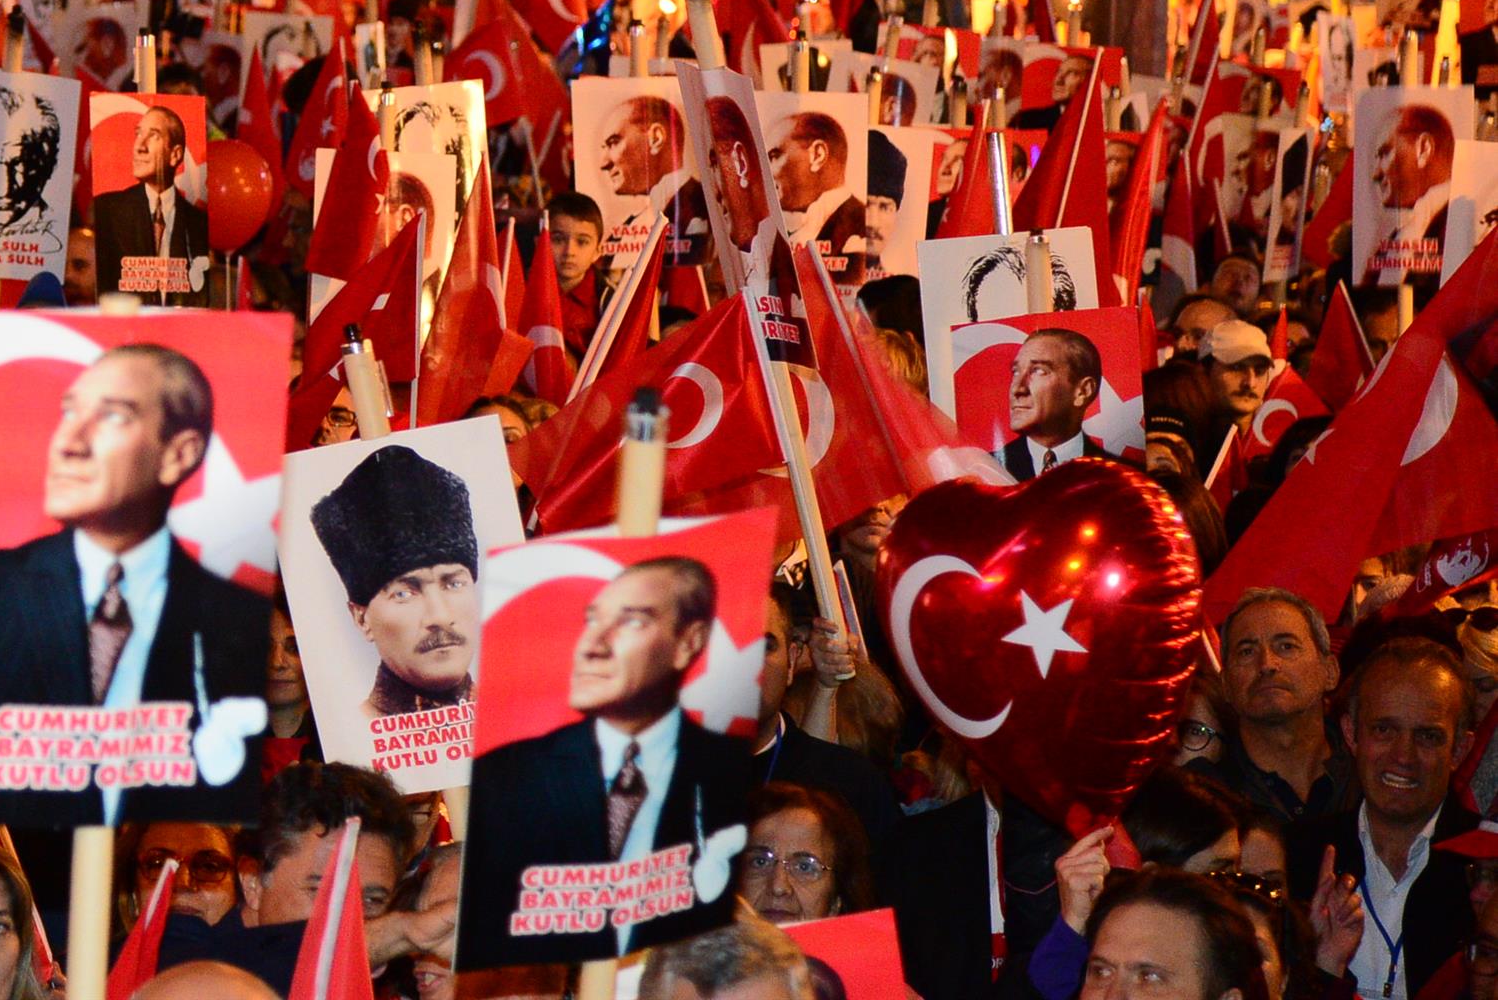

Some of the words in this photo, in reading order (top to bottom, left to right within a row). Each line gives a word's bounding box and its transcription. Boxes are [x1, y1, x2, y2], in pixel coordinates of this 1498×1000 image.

[3, 241, 39, 253] SULH
[7, 254, 45, 266] SULH
[120, 281, 157, 291] KUTLU
[369, 700, 476, 735] CUMHURİ
[373, 722, 476, 754] BAYRAMI
[371, 749, 439, 772] KUTLU
[99, 761, 194, 786] OLSUN
[522, 870, 688, 909] BAYRAMIMIZ
[512, 911, 603, 932] KUTLU
[612, 890, 691, 926] OLSUN
